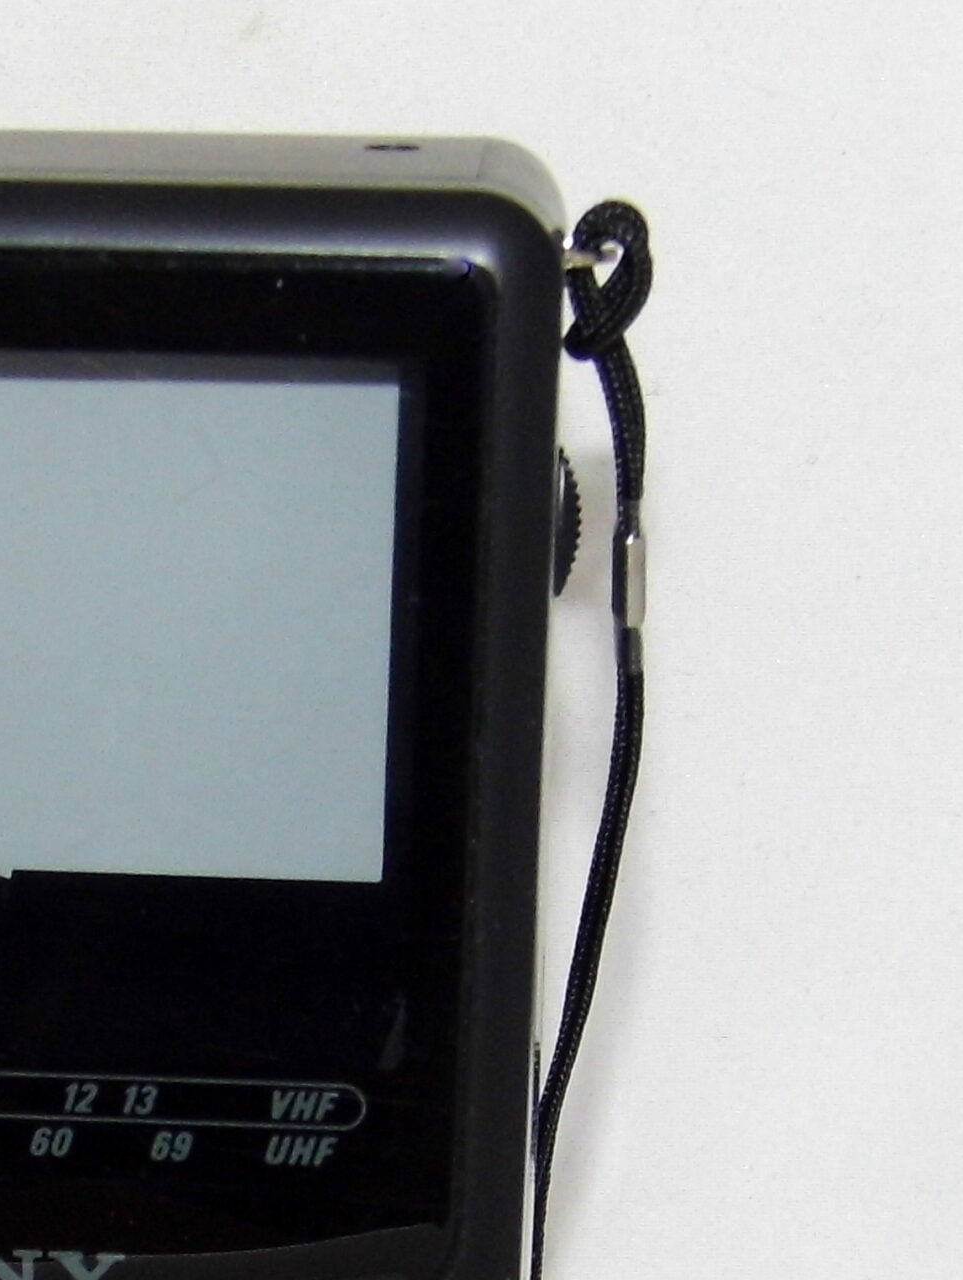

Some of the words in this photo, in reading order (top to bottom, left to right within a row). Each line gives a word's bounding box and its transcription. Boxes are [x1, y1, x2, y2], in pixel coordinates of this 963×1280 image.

[64, 1084, 98, 1113] 12
[122, 1086, 159, 1116] 13
[271, 1090, 339, 1122] VHF
[30, 1127, 74, 1158] 60
[149, 1131, 193, 1162] 69
[264, 1136, 339, 1167] UHF
